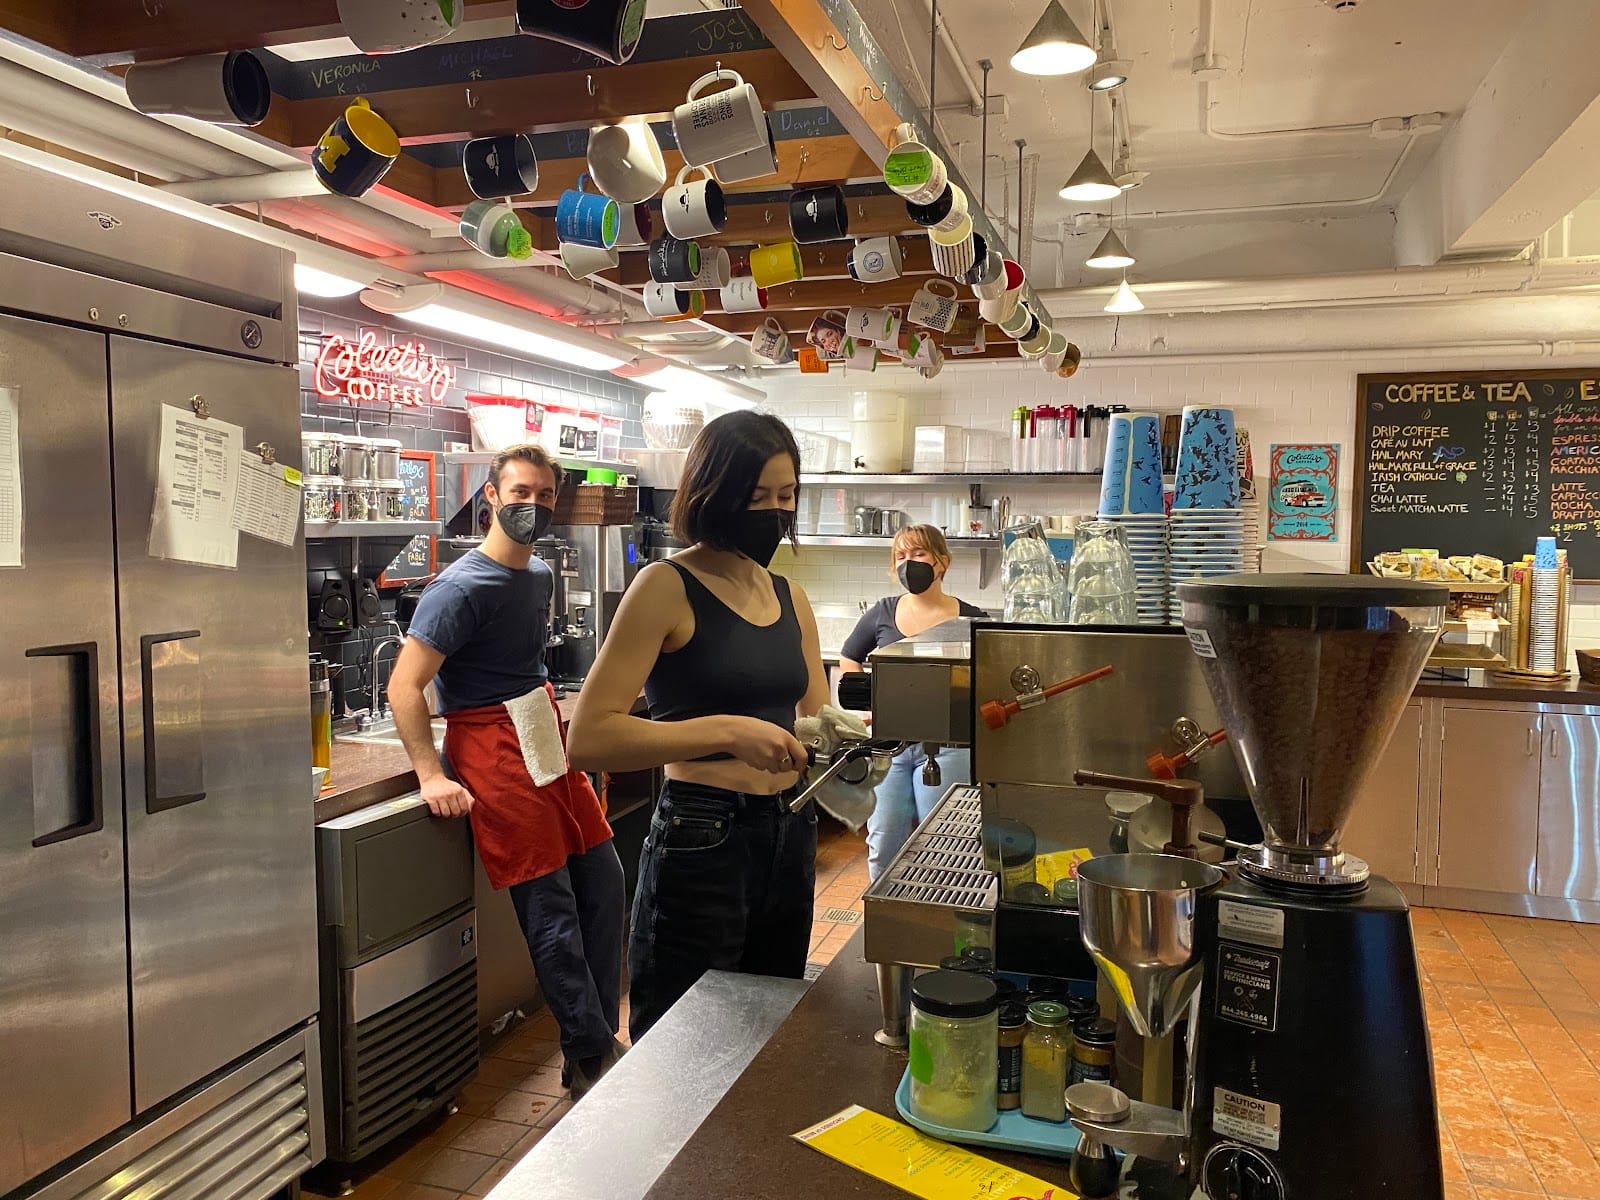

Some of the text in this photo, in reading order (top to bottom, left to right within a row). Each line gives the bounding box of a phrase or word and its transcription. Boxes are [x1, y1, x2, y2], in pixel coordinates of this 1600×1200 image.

[311, 58, 381, 90] VERONICA
[780, 106, 830, 132] Daniel
[315, 331, 454, 401] Colectivo
[347, 378, 425, 407] COFFEE
[1385, 382, 1532, 403] COFFEE & TEA
[1580, 380, 1600, 401] E
[1372, 425, 1450, 438] DRIP COFFEE
[1395, 440, 1408, 449] AU
[1412, 438, 1434, 448] LAIT
[1552, 434, 1600, 446] ESPRES
[1286, 453, 1323, 465] Colectivo
[1371, 450, 1424, 461] HAIL MARY
[1368, 462, 1388, 471] HAIL
[1413, 462, 1435, 471] FULL
[1445, 461, 1477, 472] GRACE
[1371, 472, 1447, 483] IRISH CATHOLIC
[1371, 483, 1395, 493] TEA
[1551, 482, 1588, 492] LATTE
[1371, 494, 1428, 504] CHAI LATTE
[1551, 500, 1594, 510] MOCHA
[1370, 503, 1470, 513] Sweet MATCHA LATTE
[1552, 510, 1586, 520] DRAFT
[1223, 974, 1271, 990] TECHNICIANS
[1224, 1094, 1265, 1112] CAUTION
